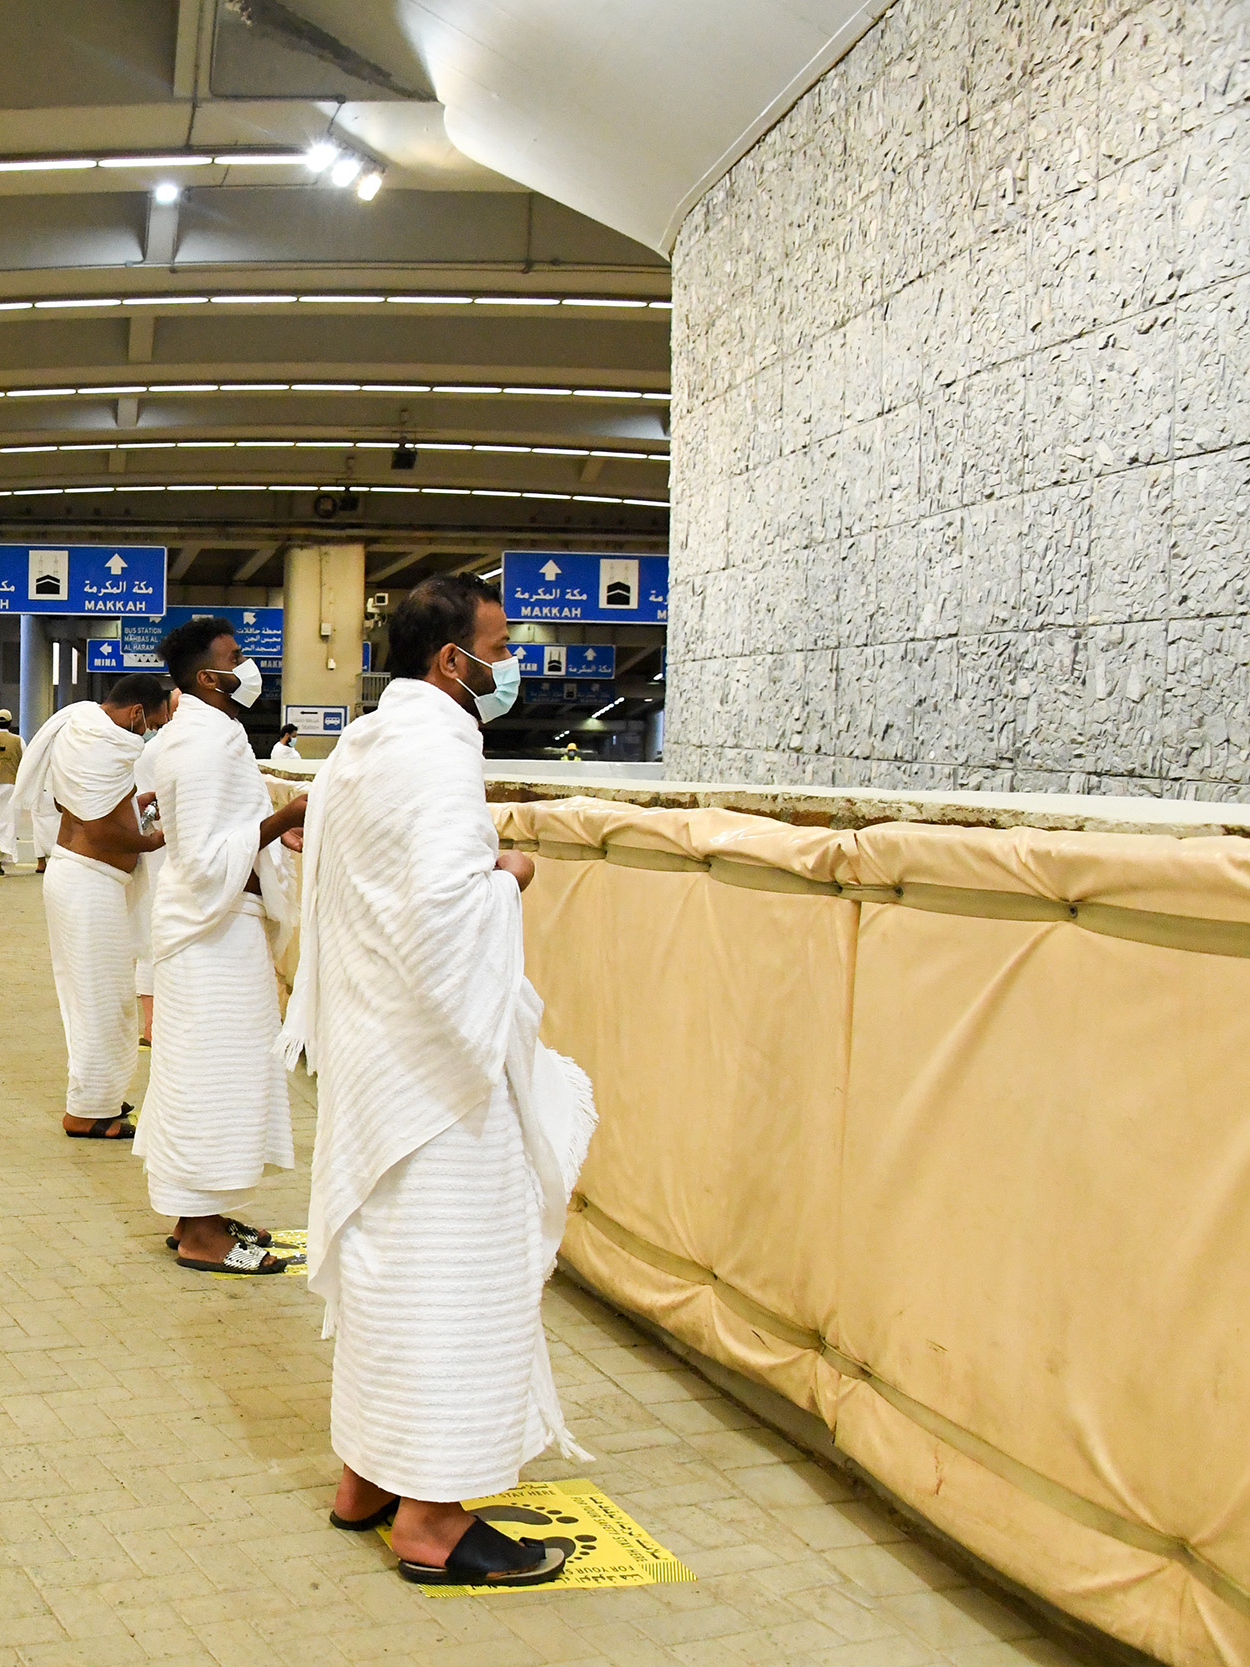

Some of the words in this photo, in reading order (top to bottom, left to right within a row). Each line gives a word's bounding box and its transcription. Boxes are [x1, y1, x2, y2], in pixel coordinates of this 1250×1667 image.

[83, 579, 127, 596] المكرمة
[132, 580, 154, 594] مكة
[514, 587, 560, 602] المكرمة
[565, 588, 588, 601] مكة
[84, 600, 147, 612] MAKKAH
[521, 606, 582, 618] MAKKAH
[239, 644, 255, 652] الحرا
[94, 658, 117, 667] MINA
[499, 1491, 524, 1499] STAY
[593, 1518, 620, 1536] SAFETY
[612, 1536, 634, 1548] STAY
[575, 1566, 609, 1575] YOUR
[575, 1574, 617, 1584] الوقوف
[619, 1573, 643, 1582] هنا
